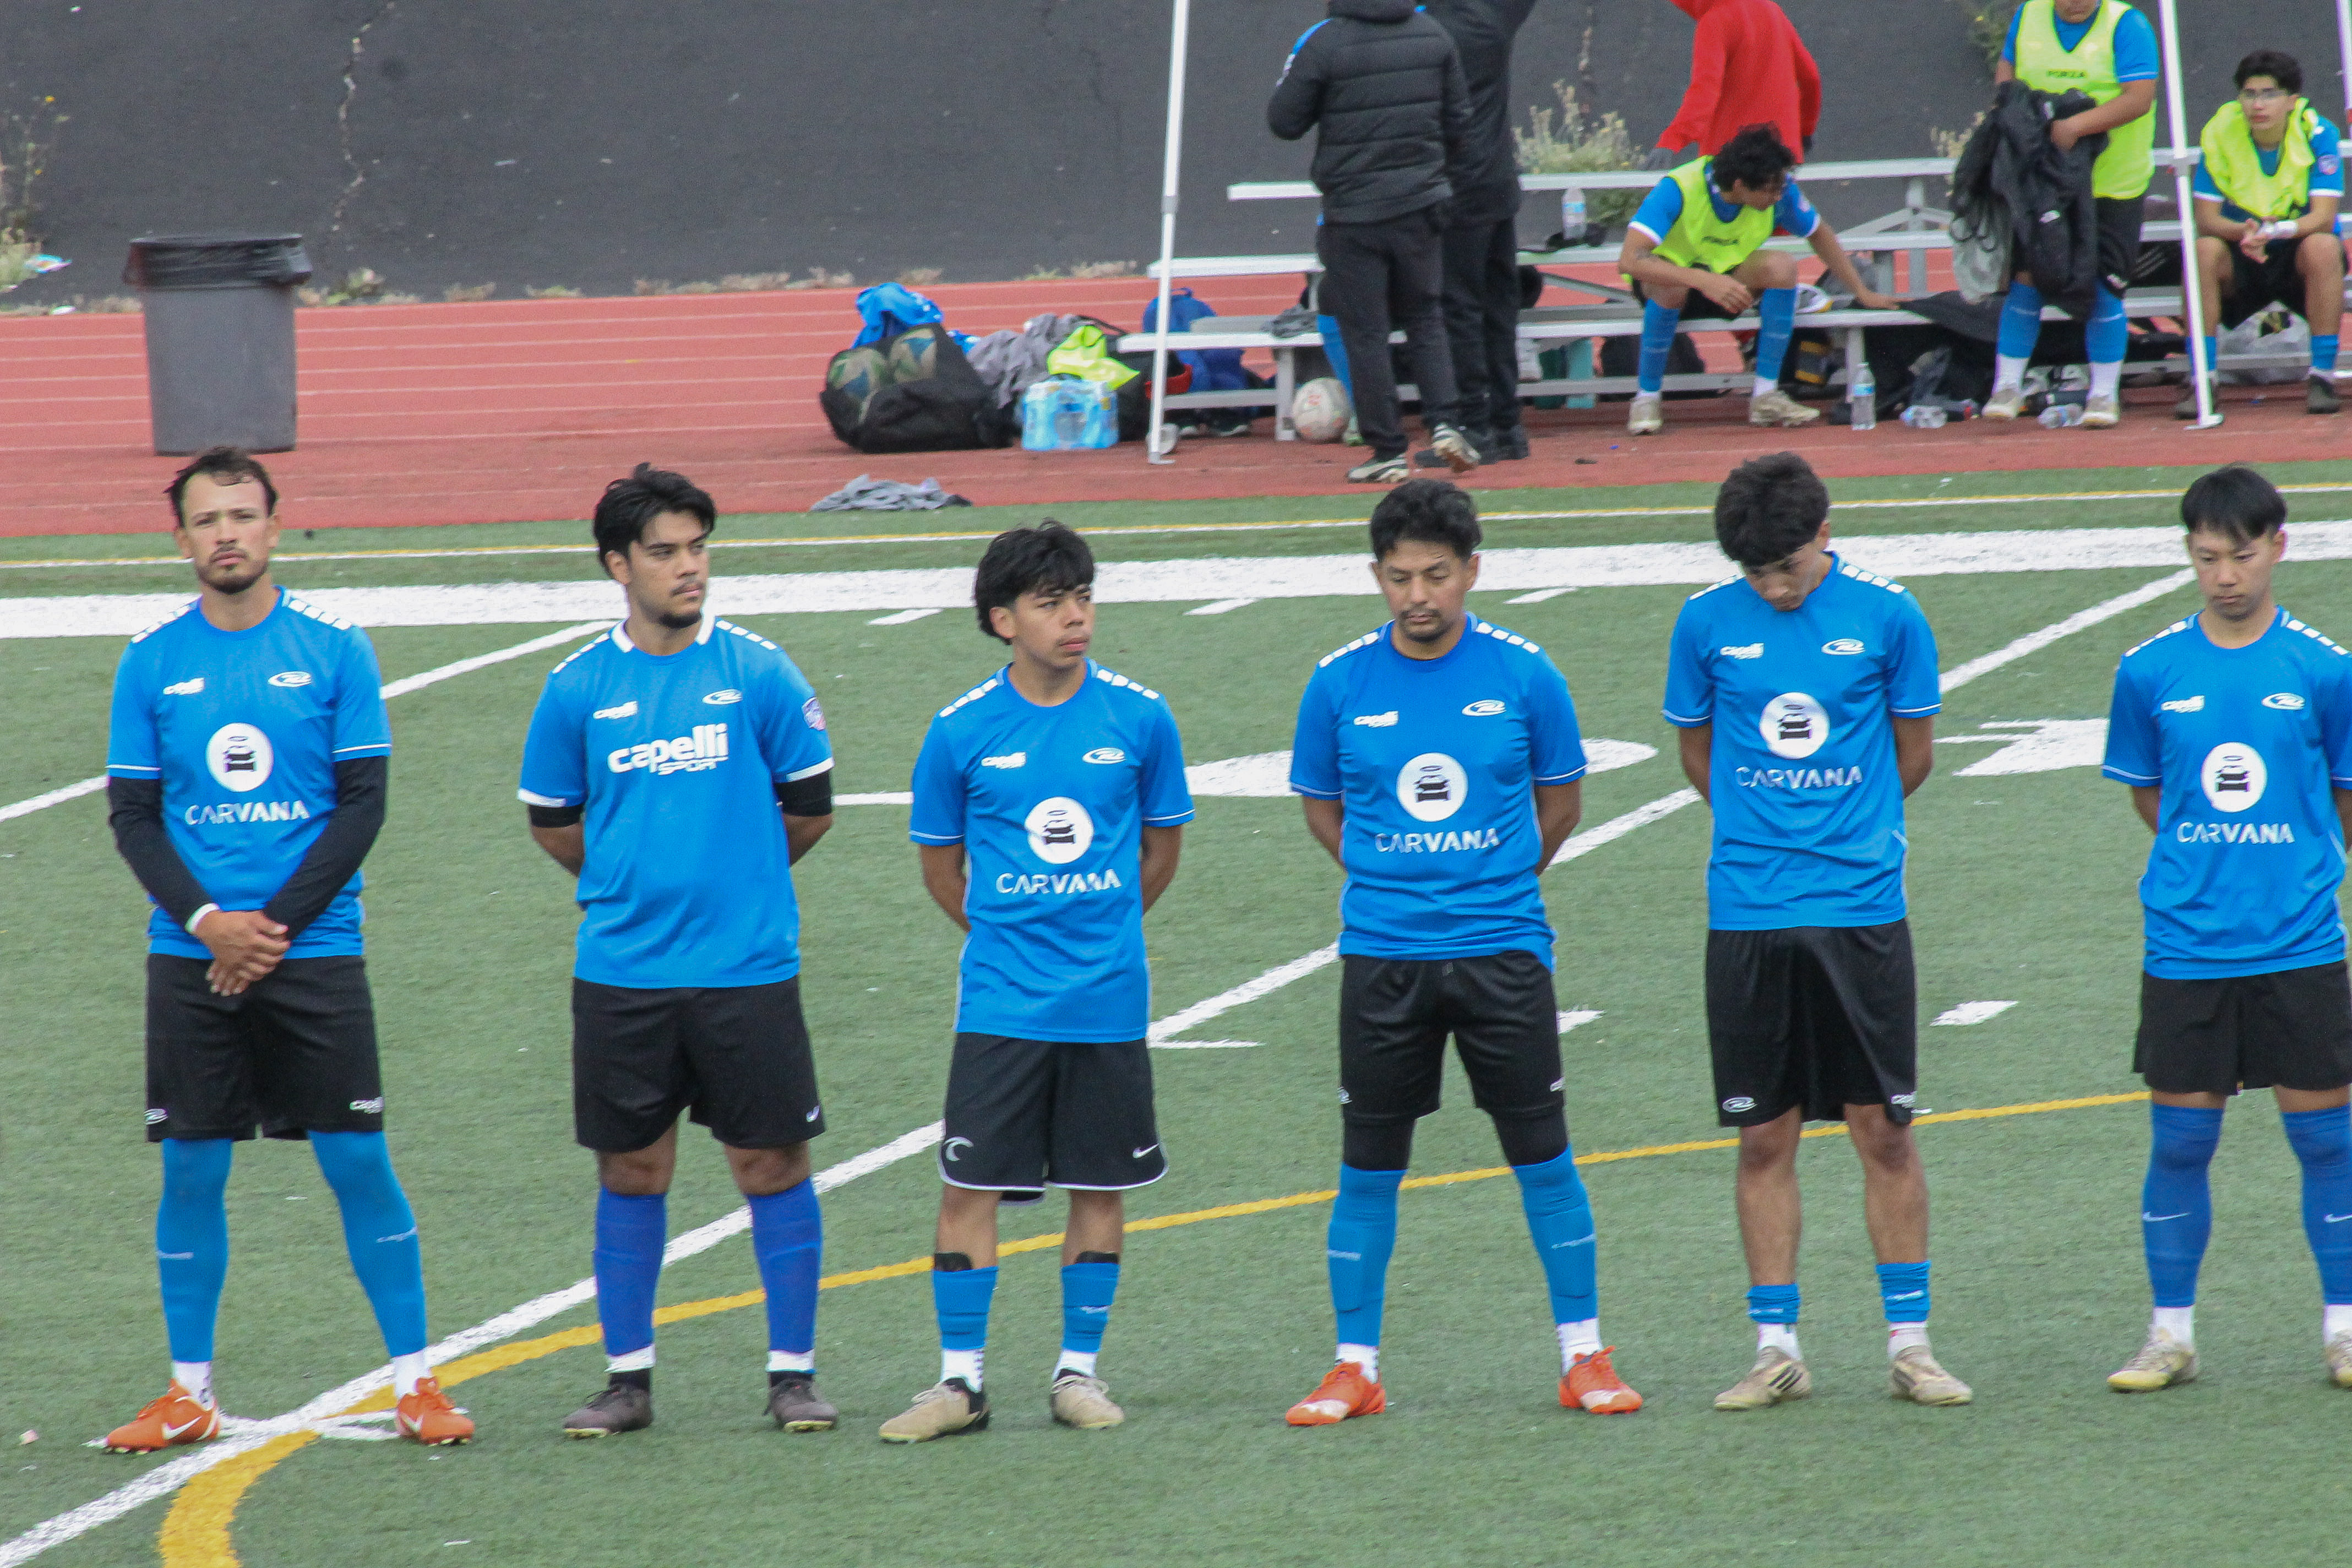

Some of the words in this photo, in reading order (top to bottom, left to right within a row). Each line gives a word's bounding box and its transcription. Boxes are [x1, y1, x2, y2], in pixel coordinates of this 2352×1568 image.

[607, 722, 728, 774] capelli
[1735, 765, 1863, 789] CARVANA
[184, 799, 311, 825] CARVANA
[1375, 827, 1501, 853] CARVANA
[2176, 821, 2295, 844] CARVANA
[995, 868, 1123, 895] CARVANA
